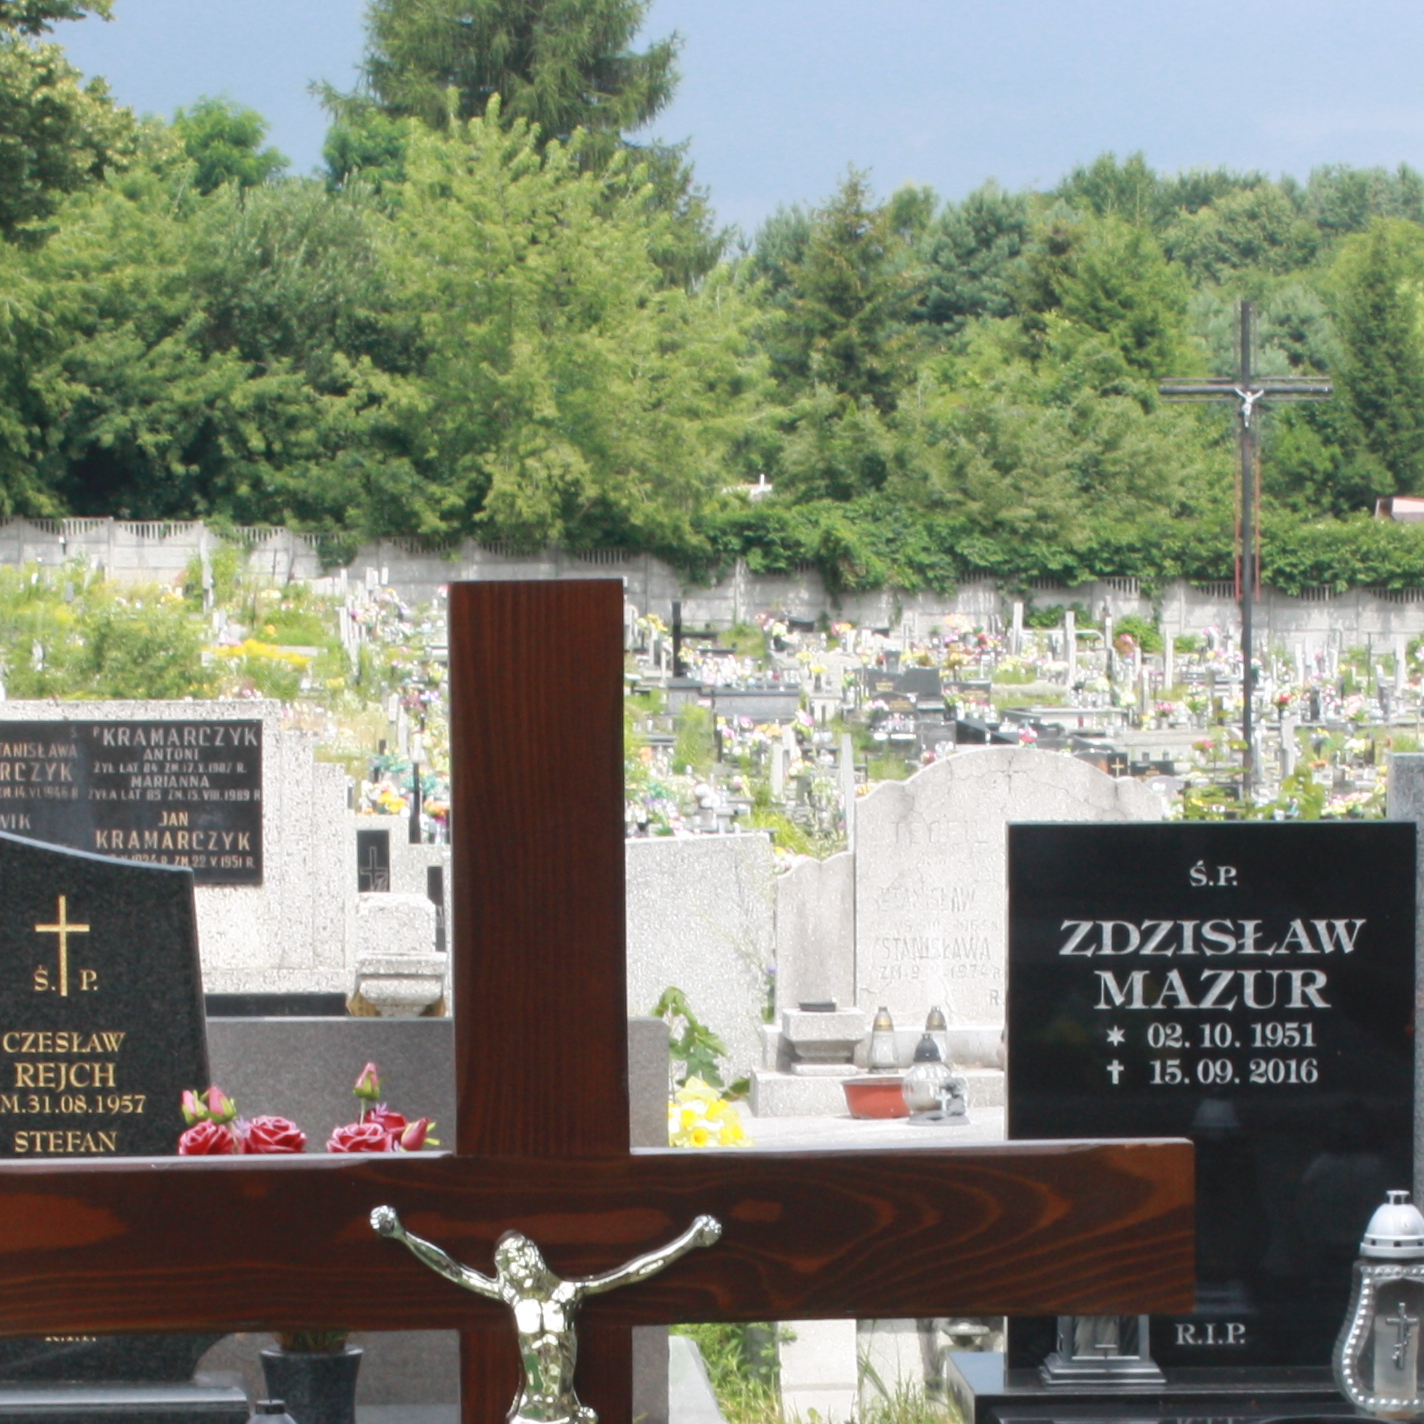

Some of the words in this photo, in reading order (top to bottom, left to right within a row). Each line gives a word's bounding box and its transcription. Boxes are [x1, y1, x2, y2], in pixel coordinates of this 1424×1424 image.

[102, 726, 259, 747] KRAMARCZYK
[142, 747, 200, 761] ANTONI
[119, 762, 139, 774] LAT
[130, 774, 210, 789] MARIANNA
[121, 788, 141, 801] LAT
[157, 811, 189, 827] JAN
[95, 830, 251, 851] KRAMARCZYK
[1188, 860, 1239, 888] Ś.P.
[1058, 918, 1367, 958] ZDZISŁAW
[1093, 967, 1331, 1011] MAZUR
[2, 1031, 126, 1054] CZESŁAW
[13, 1061, 117, 1092] REJCH
[14, 1130, 117, 1153] STEFAN
[1174, 1323, 1247, 1346] R.I.P.
